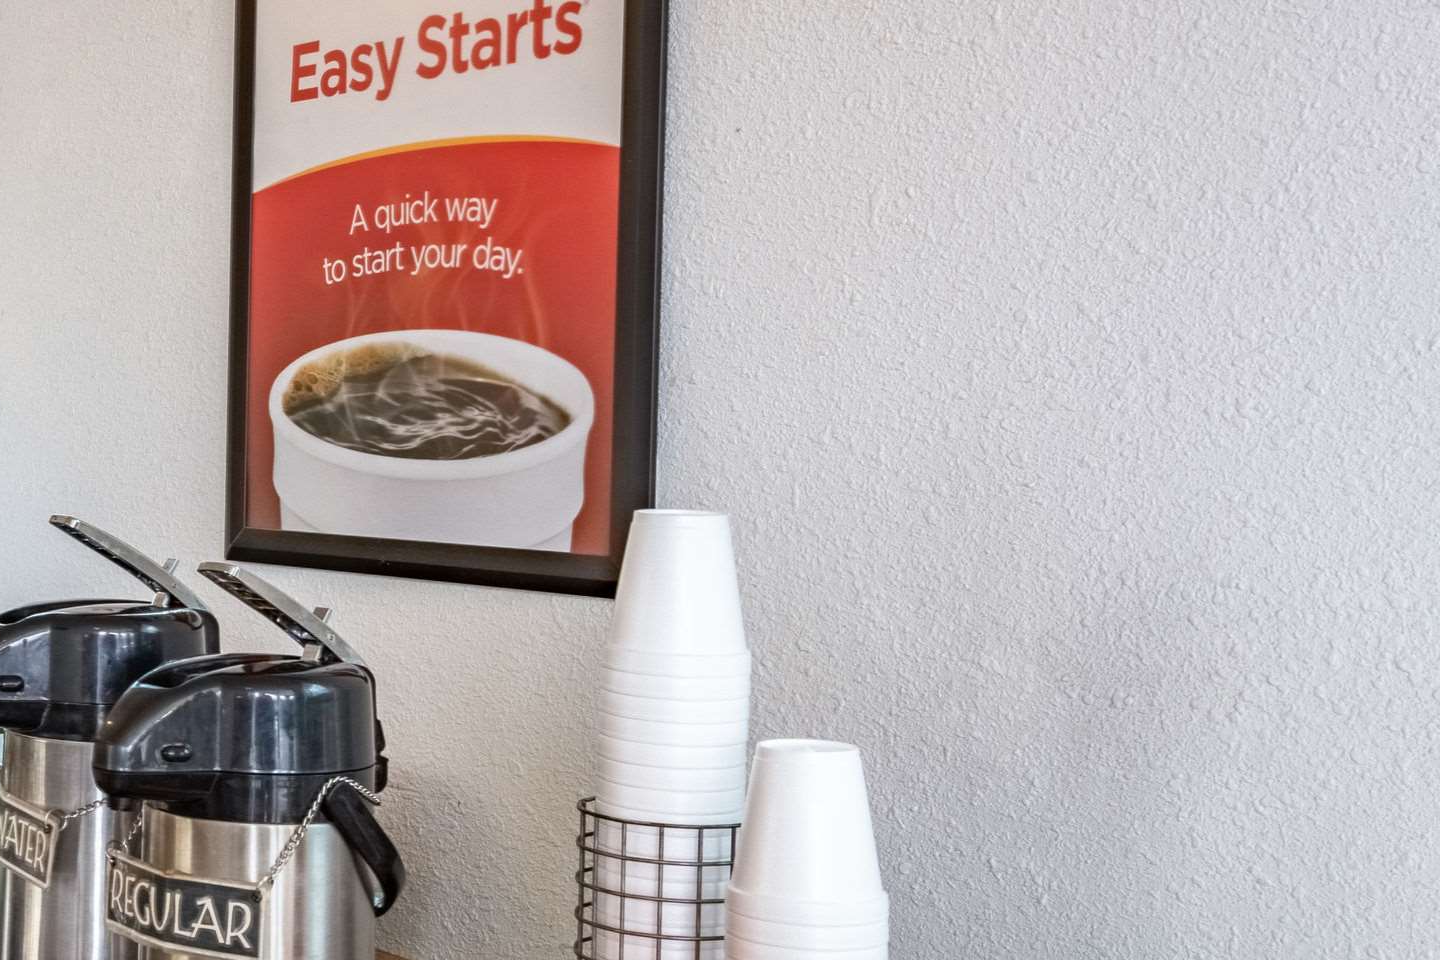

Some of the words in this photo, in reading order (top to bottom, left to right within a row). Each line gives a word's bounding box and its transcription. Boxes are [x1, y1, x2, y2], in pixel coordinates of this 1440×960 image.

[290, 36, 404, 102] Easy
[416, 0, 583, 79] Starts
[349, 204, 368, 235] A
[374, 191, 437, 234] quick
[445, 196, 497, 229] way
[323, 257, 345, 285] to
[352, 242, 404, 278] start
[410, 243, 467, 275] your
[472, 237, 523, 279] day.
[111, 868, 251, 949] REGULAR
